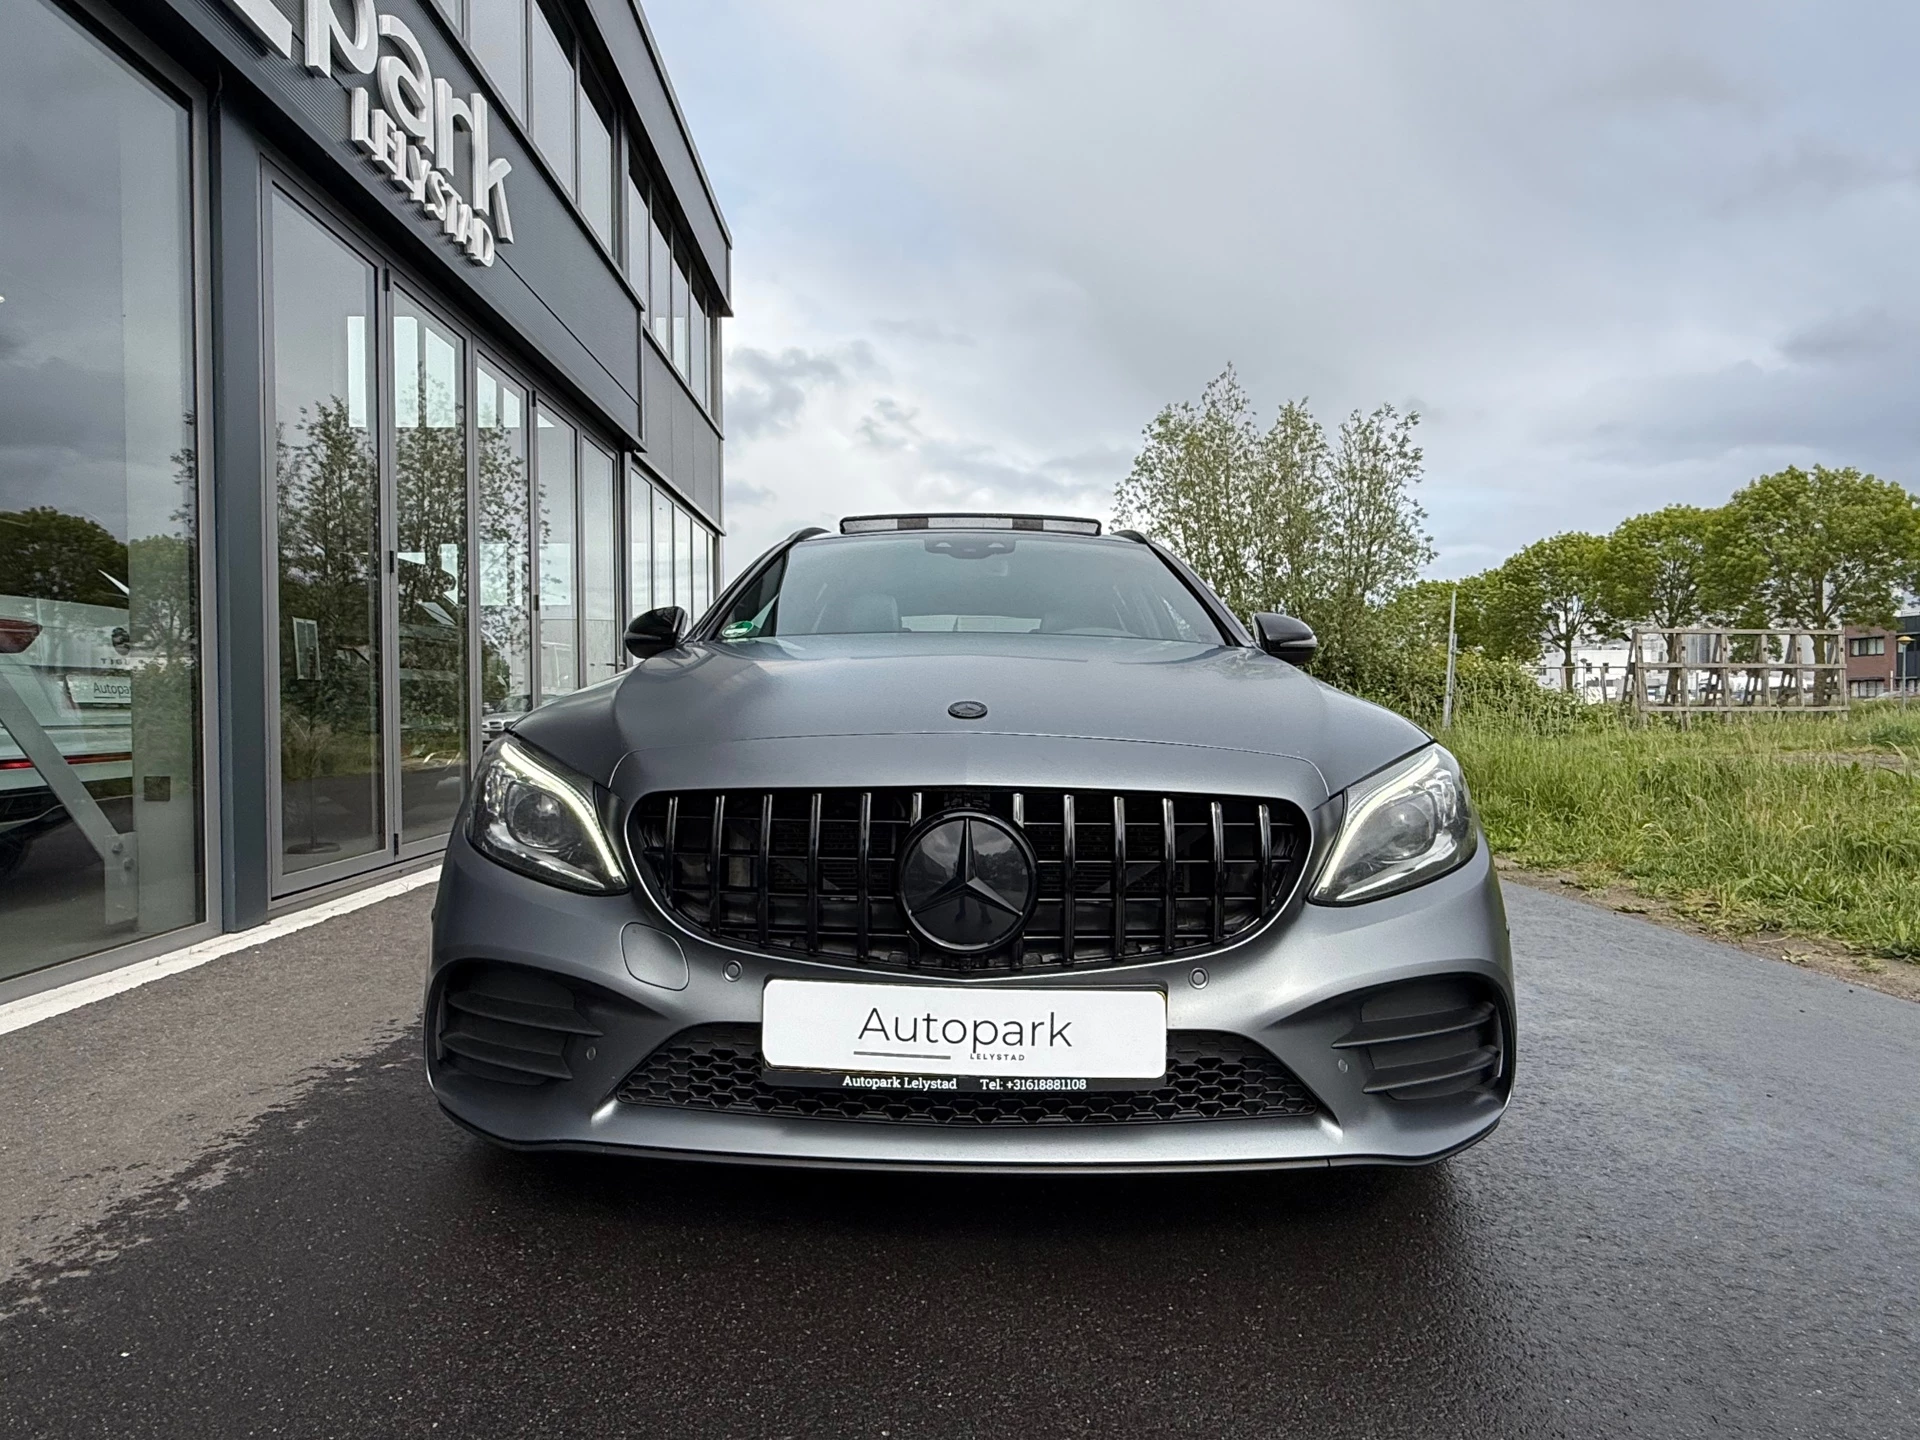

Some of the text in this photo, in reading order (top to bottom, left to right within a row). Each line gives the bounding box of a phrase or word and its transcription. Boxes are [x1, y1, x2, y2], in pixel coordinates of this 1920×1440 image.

[351, 87, 495, 267] LELYSTAD
[94, 681, 131, 697] Autopa
[858, 1007, 1073, 1054] Autopark
[970, 1053, 1026, 1061] LELYSTAD
[842, 1075, 1087, 1091] Autopark Lelystad Tel: +31618881108
